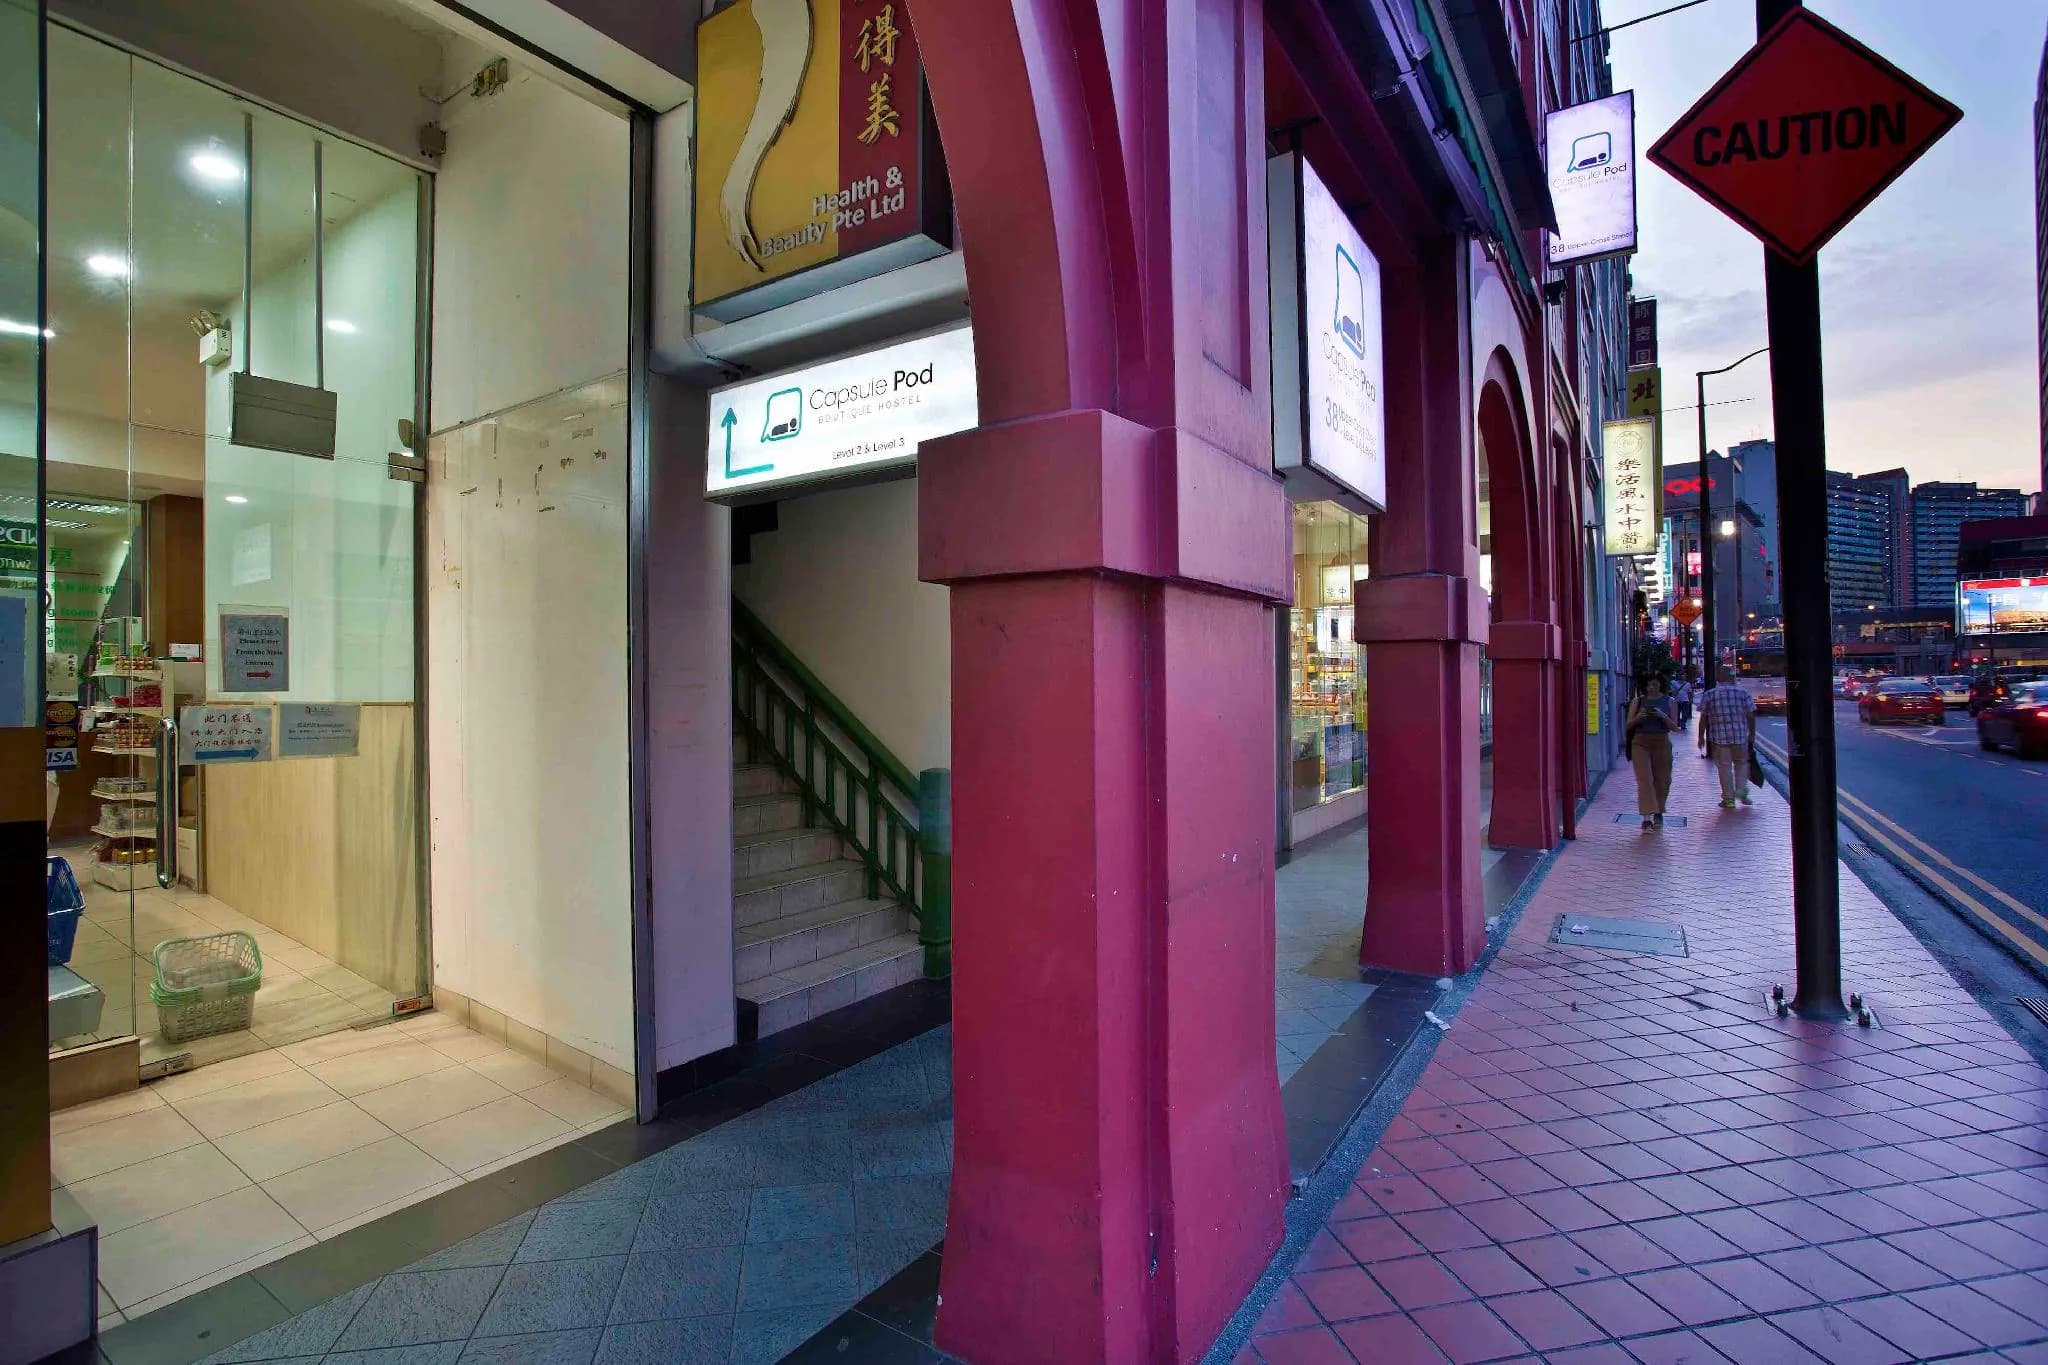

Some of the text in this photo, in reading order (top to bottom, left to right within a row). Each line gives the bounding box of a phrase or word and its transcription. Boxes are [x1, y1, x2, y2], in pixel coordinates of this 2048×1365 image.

[1692, 102, 1907, 167] CAUTION
[1604, 163, 1627, 177] Pod
[812, 166, 903, 217] Health &
[761, 188, 905, 257] Beauty Pte Ltd
[1551, 244, 1565, 255] 38
[809, 362, 933, 410] Capsule Pod
[818, 395, 921, 425] BOUTIQUE HOSTEL
[1325, 396, 1339, 432] 38
[832, 437, 905, 460] Level 2 & Level 3
